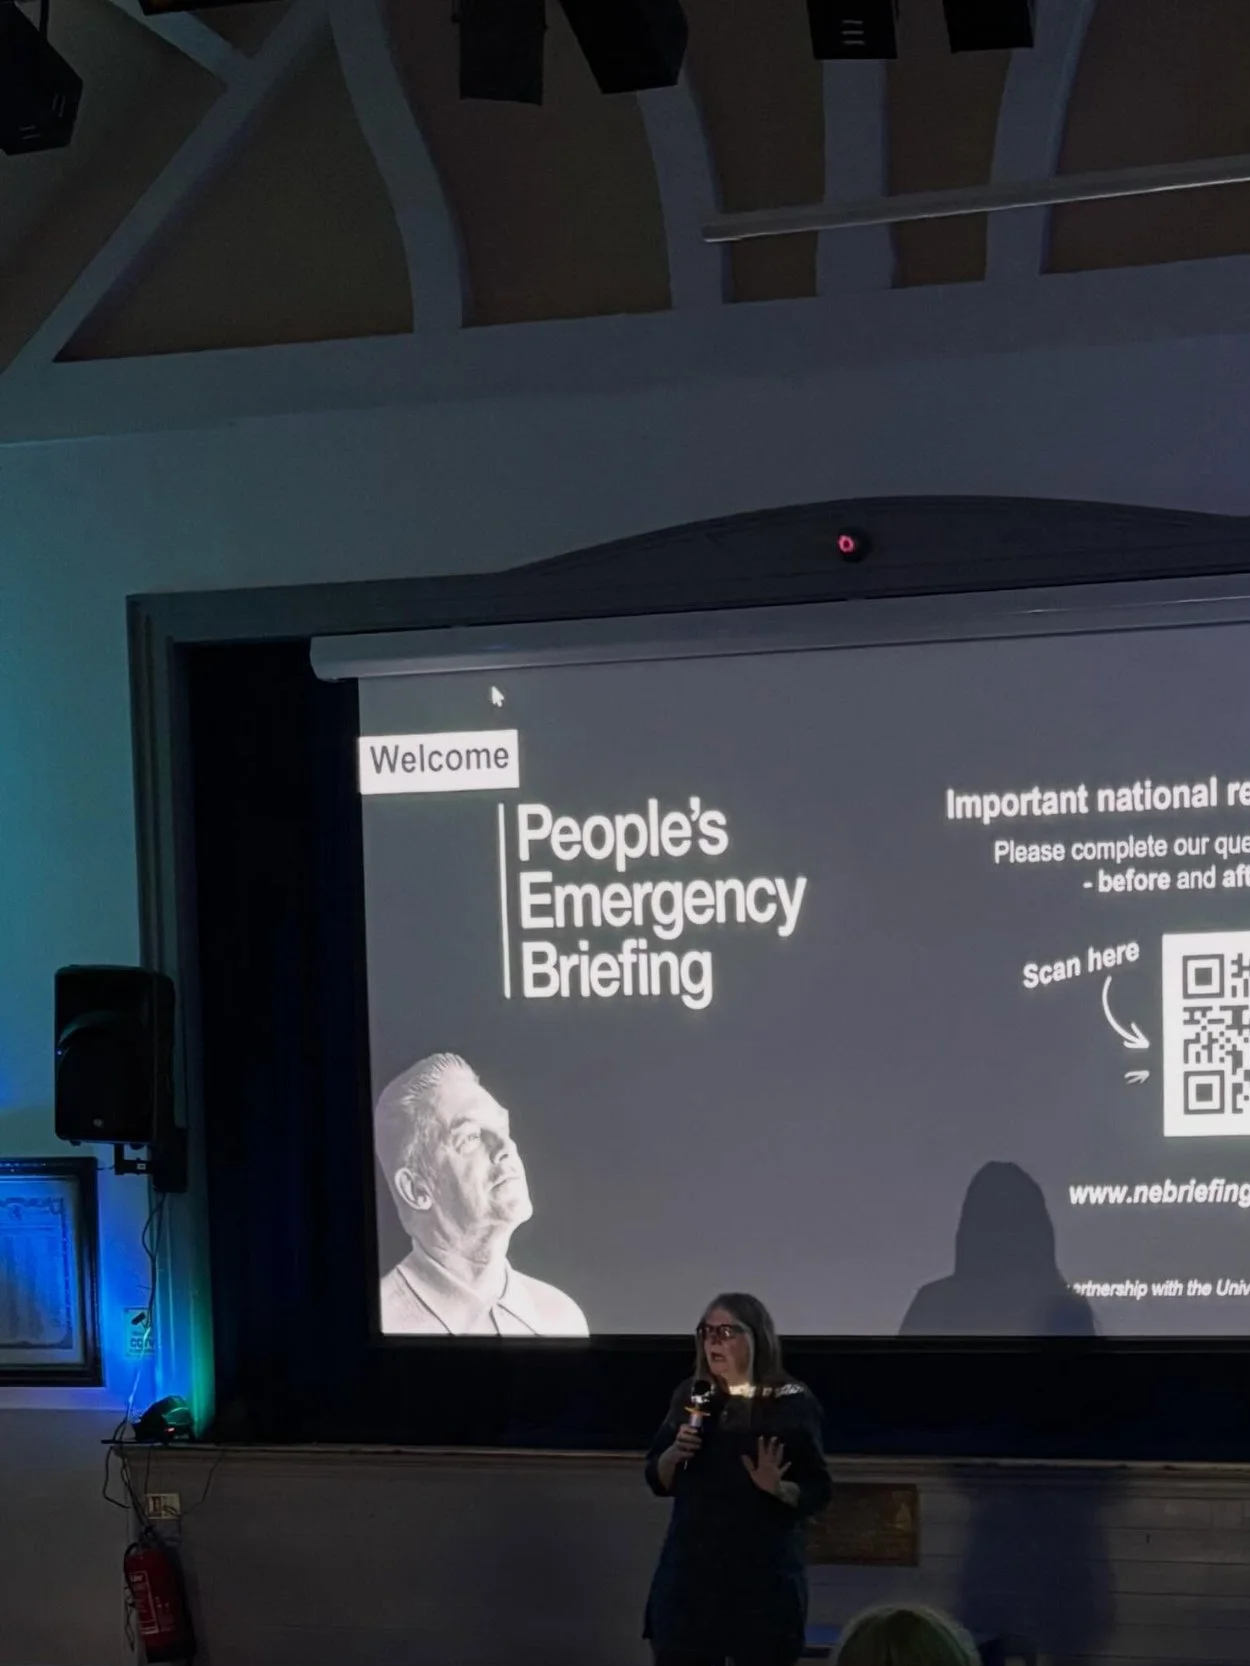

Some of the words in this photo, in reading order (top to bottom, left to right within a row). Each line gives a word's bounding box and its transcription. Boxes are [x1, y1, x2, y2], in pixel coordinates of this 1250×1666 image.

[370, 744, 509, 774] Welcome
[947, 784, 1088, 824] Important
[1097, 776, 1217, 812] national
[995, 840, 1065, 863] Please
[1071, 835, 1168, 864] complete
[1174, 837, 1210, 856] our
[1099, 868, 1171, 892] before
[1177, 865, 1216, 889] and
[520, 871, 807, 938] Emergency
[522, 939, 713, 1009] Briefing
[1023, 957, 1081, 988] Scan
[1088, 942, 1139, 972] here
[1067, 1280, 1148, 1300] artnership
[1152, 1280, 1183, 1296] with
[1187, 1279, 1212, 1296] the
